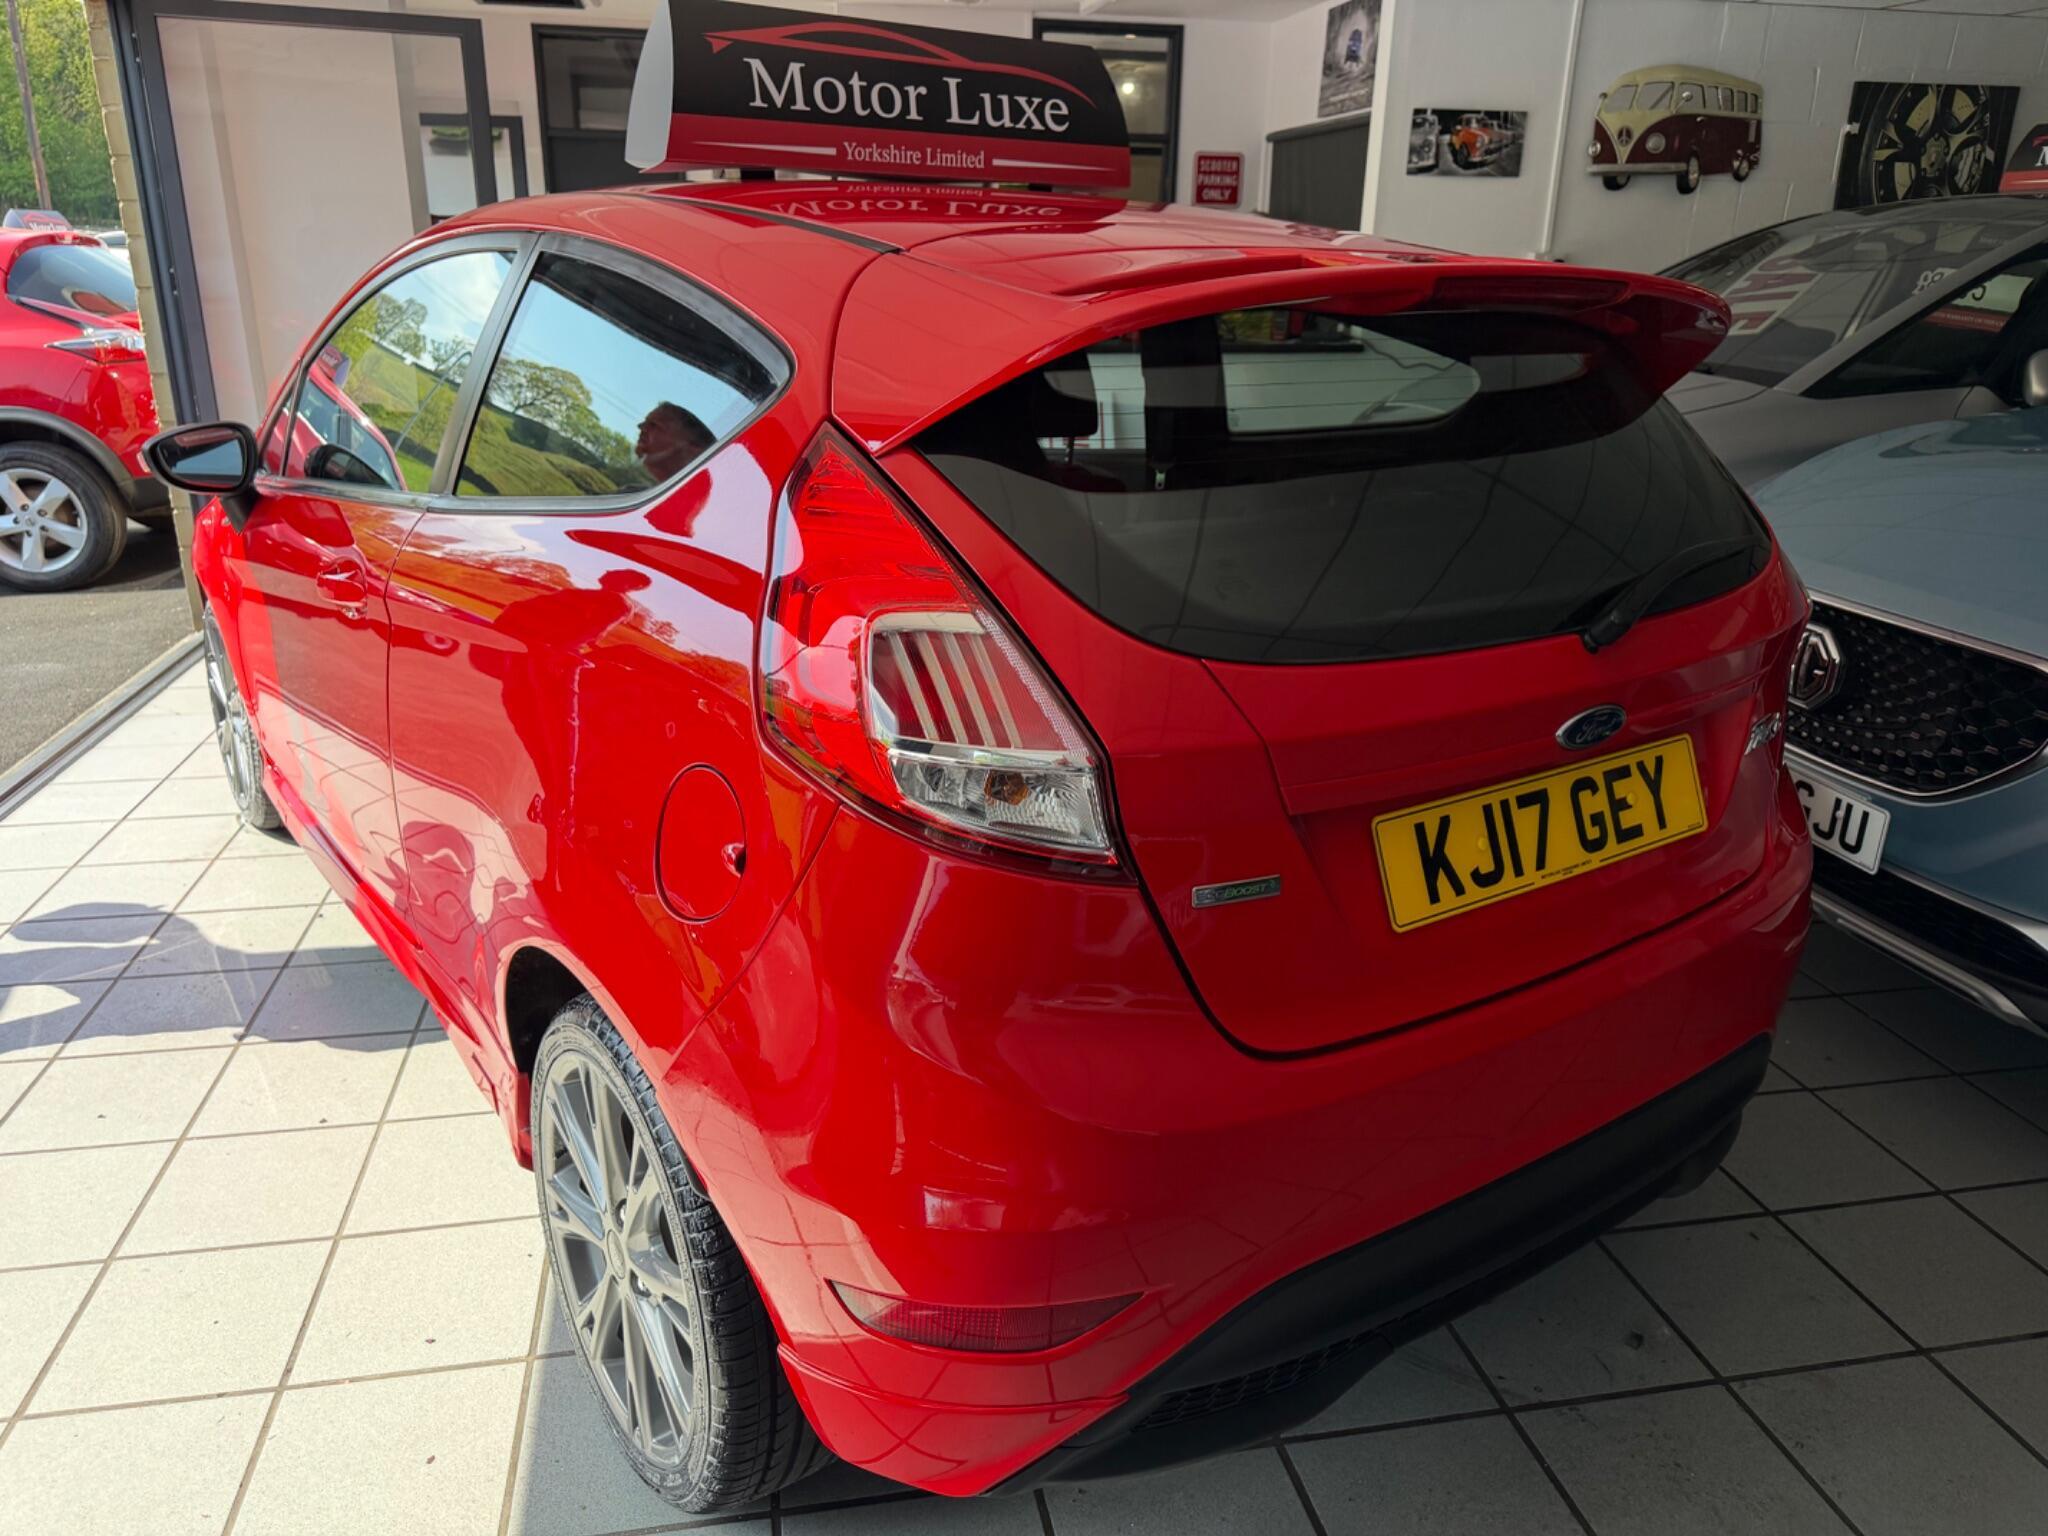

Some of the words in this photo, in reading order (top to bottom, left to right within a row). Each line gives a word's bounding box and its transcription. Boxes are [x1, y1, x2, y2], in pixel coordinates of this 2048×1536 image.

[744, 58, 927, 121] Motor
[943, 77, 1069, 132] Luxe
[843, 141, 921, 165] Yorkshire
[926, 148, 985, 169] Limited
[1202, 188, 1231, 200] ONLY
[1414, 788, 1549, 905] KJ17
[1570, 755, 1667, 854] GEY
